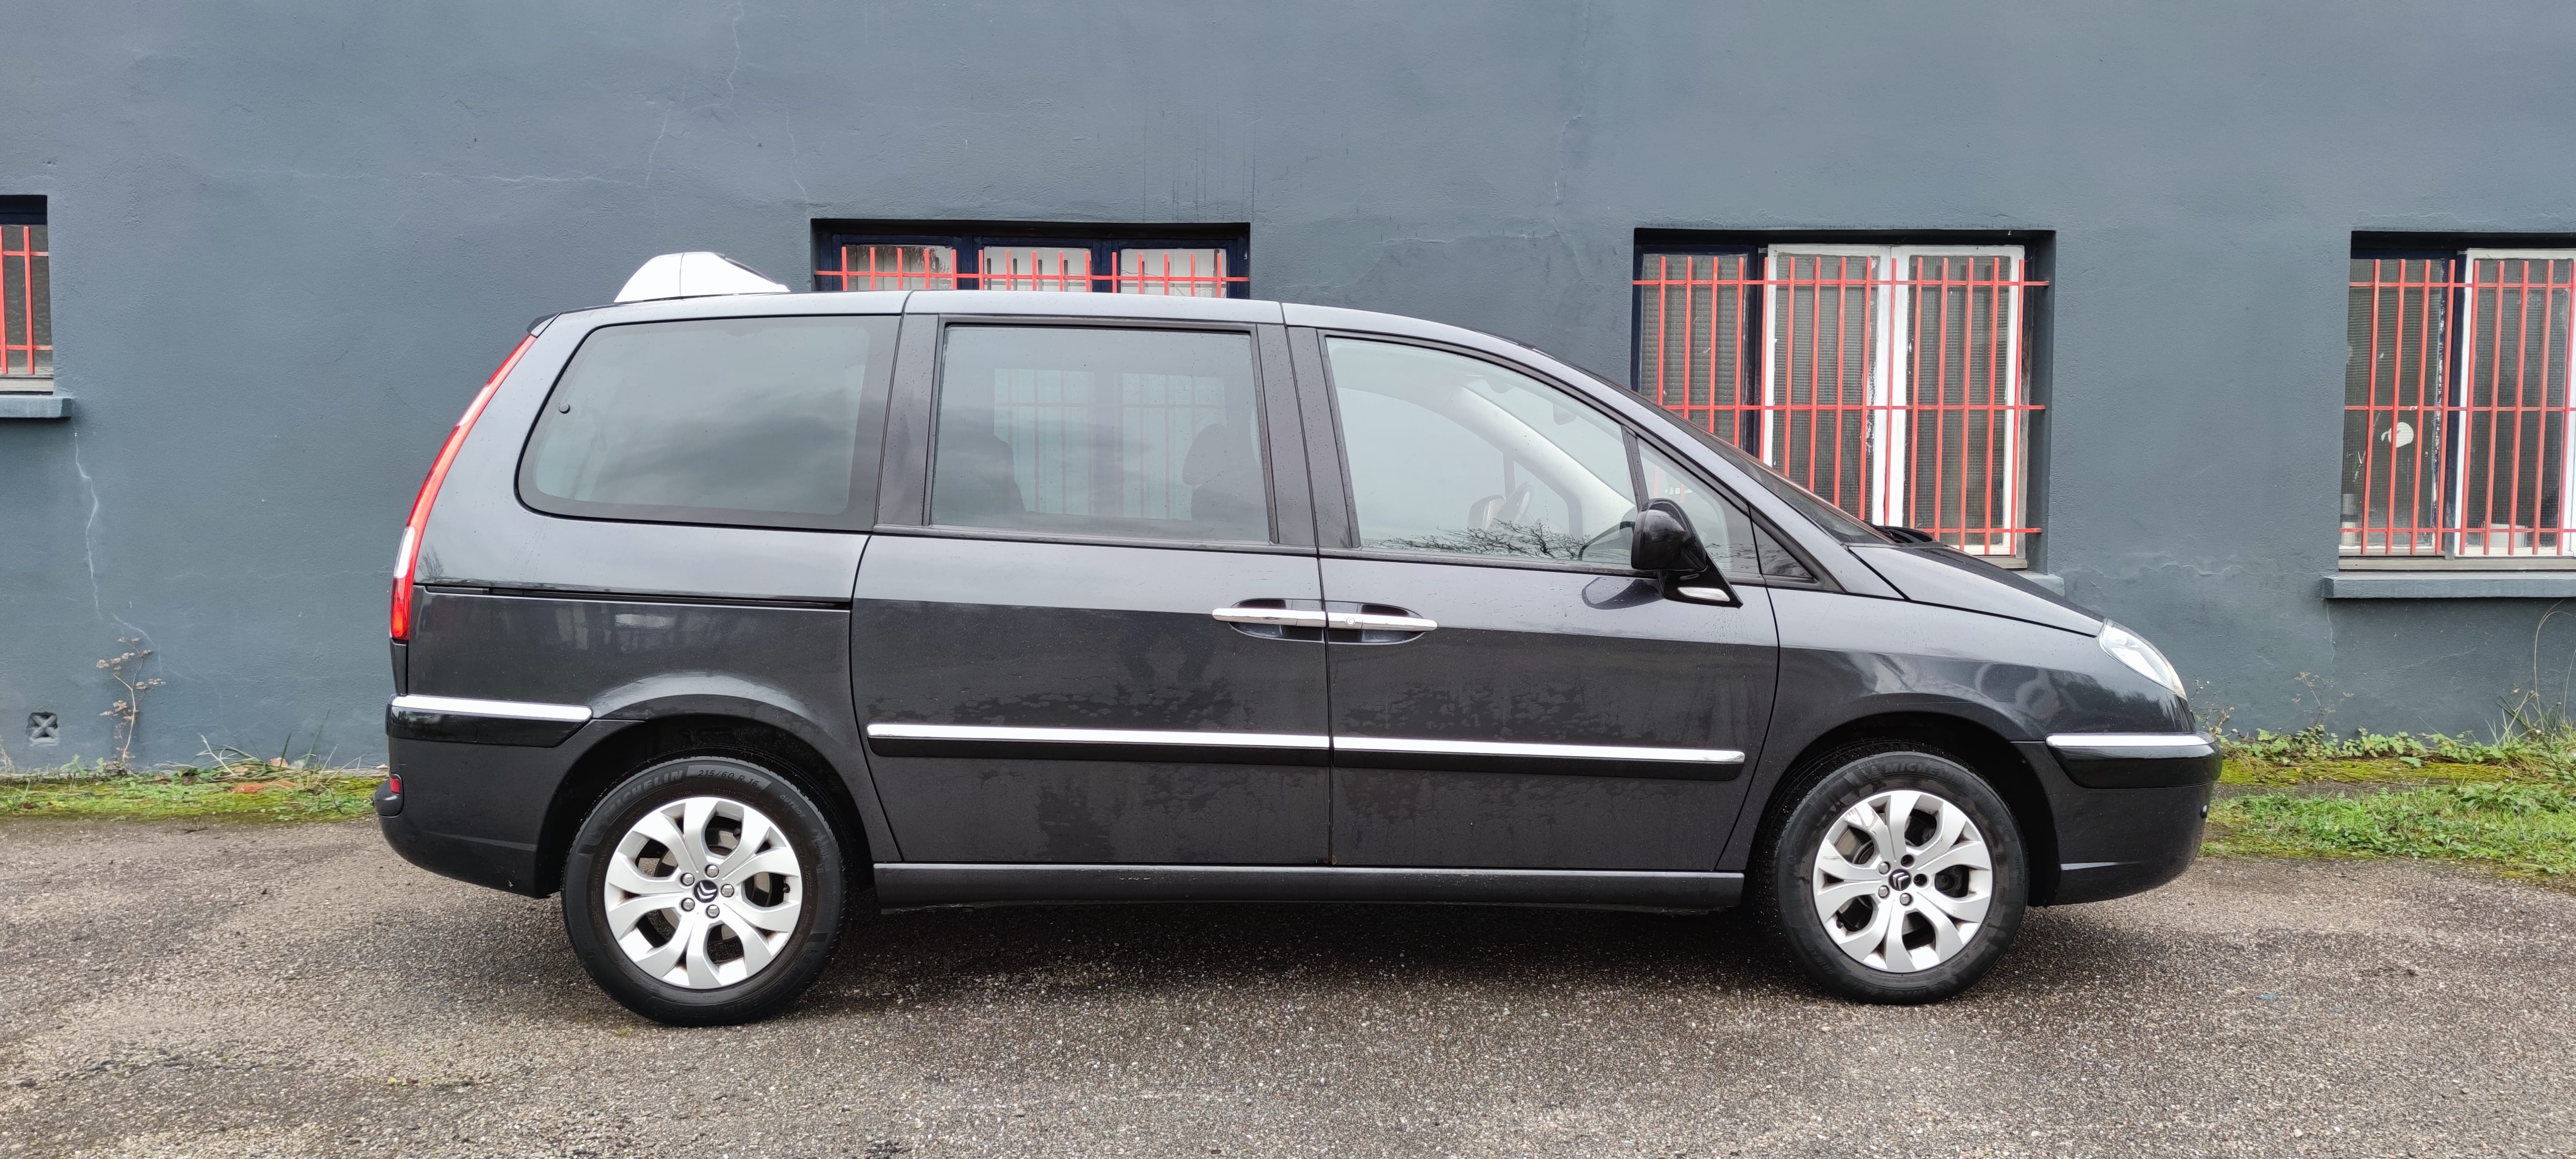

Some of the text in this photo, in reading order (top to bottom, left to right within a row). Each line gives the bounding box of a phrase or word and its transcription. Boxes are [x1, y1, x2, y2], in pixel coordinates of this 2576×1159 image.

[698, 769, 735, 779] 215/60
[748, 778, 760, 787] 16
[604, 770, 683, 823] MICHELIN
[780, 794, 806, 819] OUTSIDE
